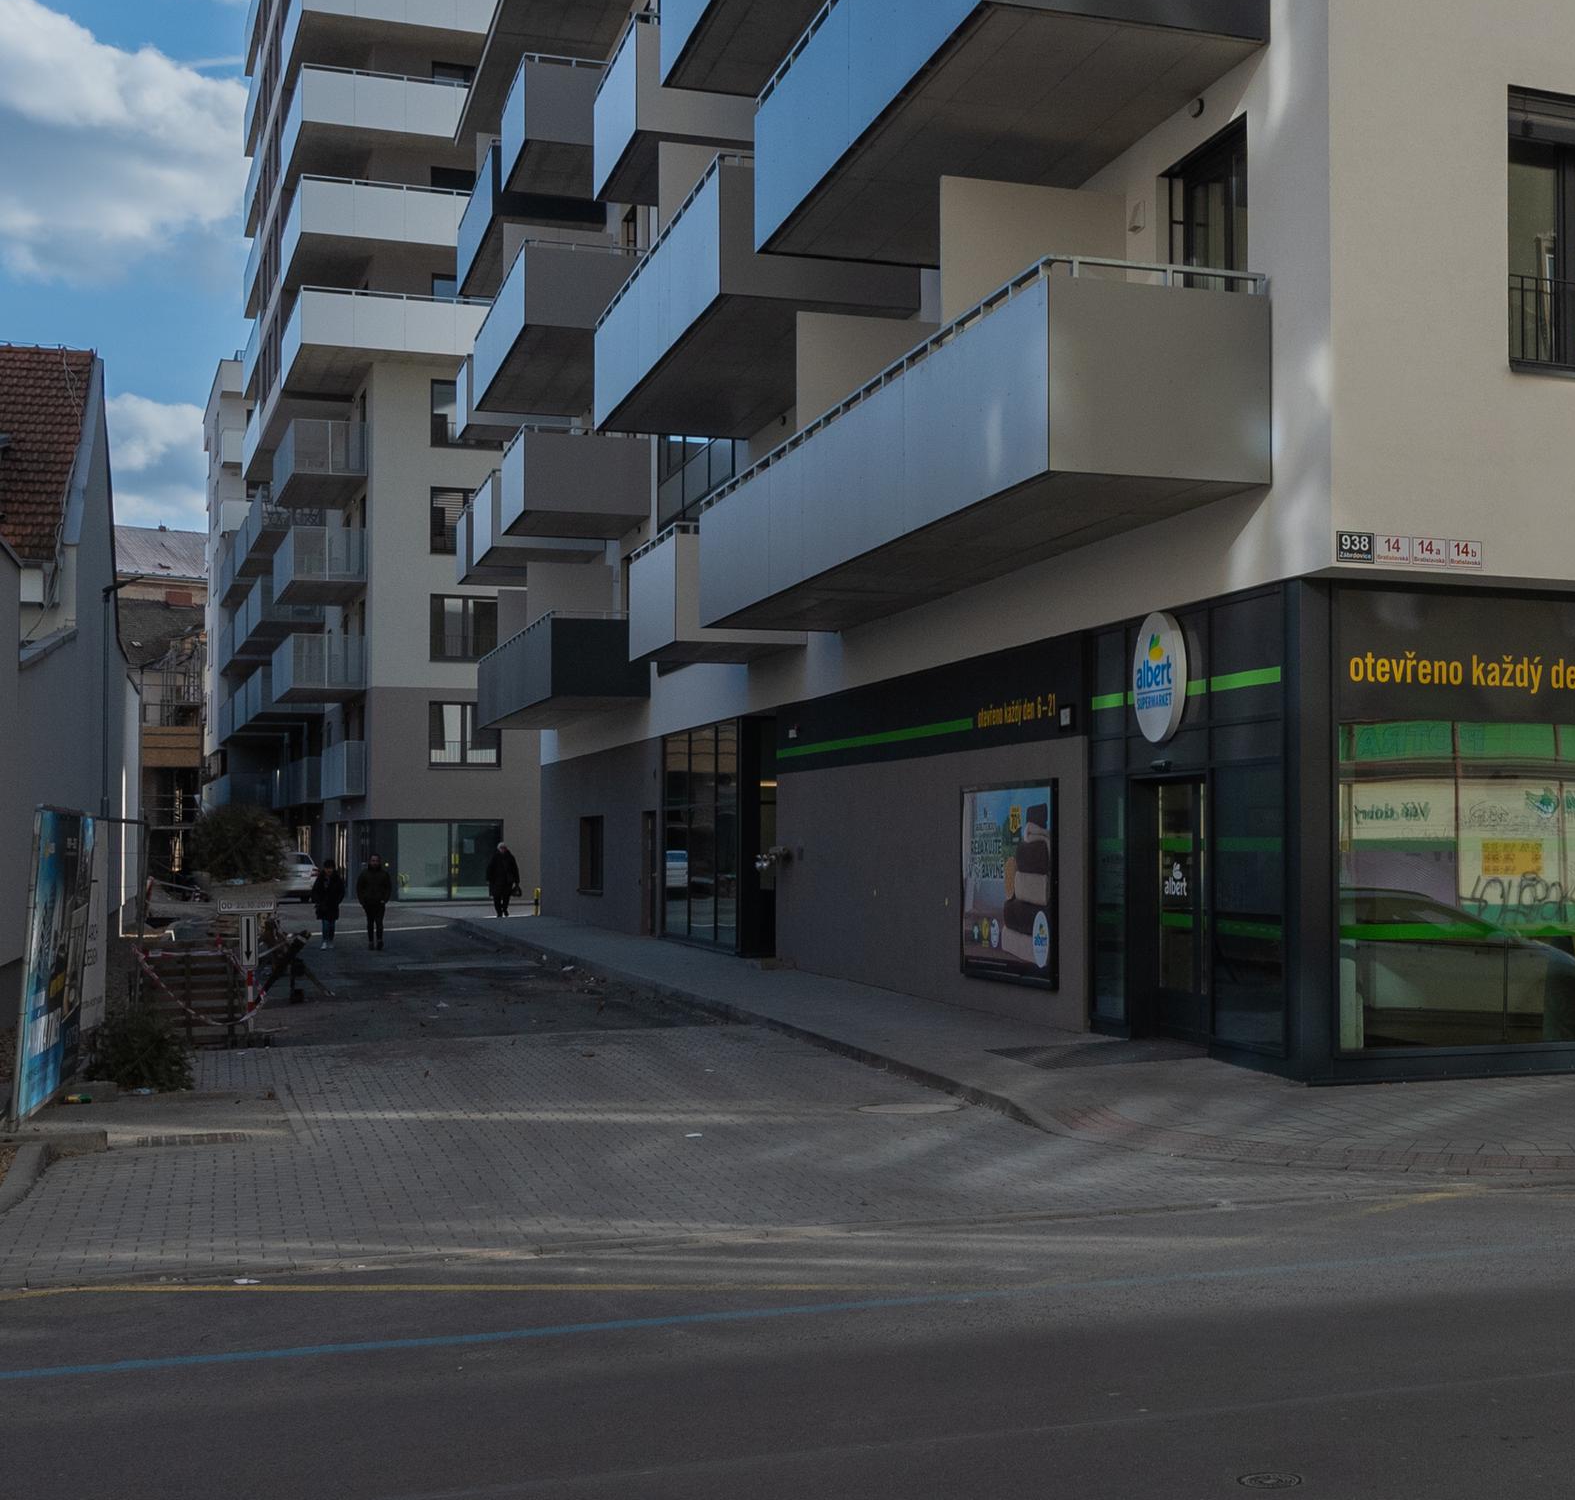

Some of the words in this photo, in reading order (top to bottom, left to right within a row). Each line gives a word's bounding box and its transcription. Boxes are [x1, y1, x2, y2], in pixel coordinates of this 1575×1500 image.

[1341, 535, 1369, 551] 938
[1384, 538, 1401, 553] 14
[1418, 540, 1434, 555] 14
[1435, 548, 1441, 556] a
[1454, 542, 1470, 557] 14
[1471, 549, 1477, 558] b
[1414, 556, 1445, 564] Bratislavská
[1450, 557, 1481, 566] Bratislavská
[1136, 656, 1172, 690] albert
[1350, 651, 1463, 686] otevřeno
[1472, 654, 1543, 694] každý
[1136, 692, 1172, 710] SUPERMARKET
[977, 703, 1003, 729] otevřeno
[1004, 699, 1022, 727] každý
[1022, 697, 1035, 722] den
[1164, 876, 1188, 897] albert
